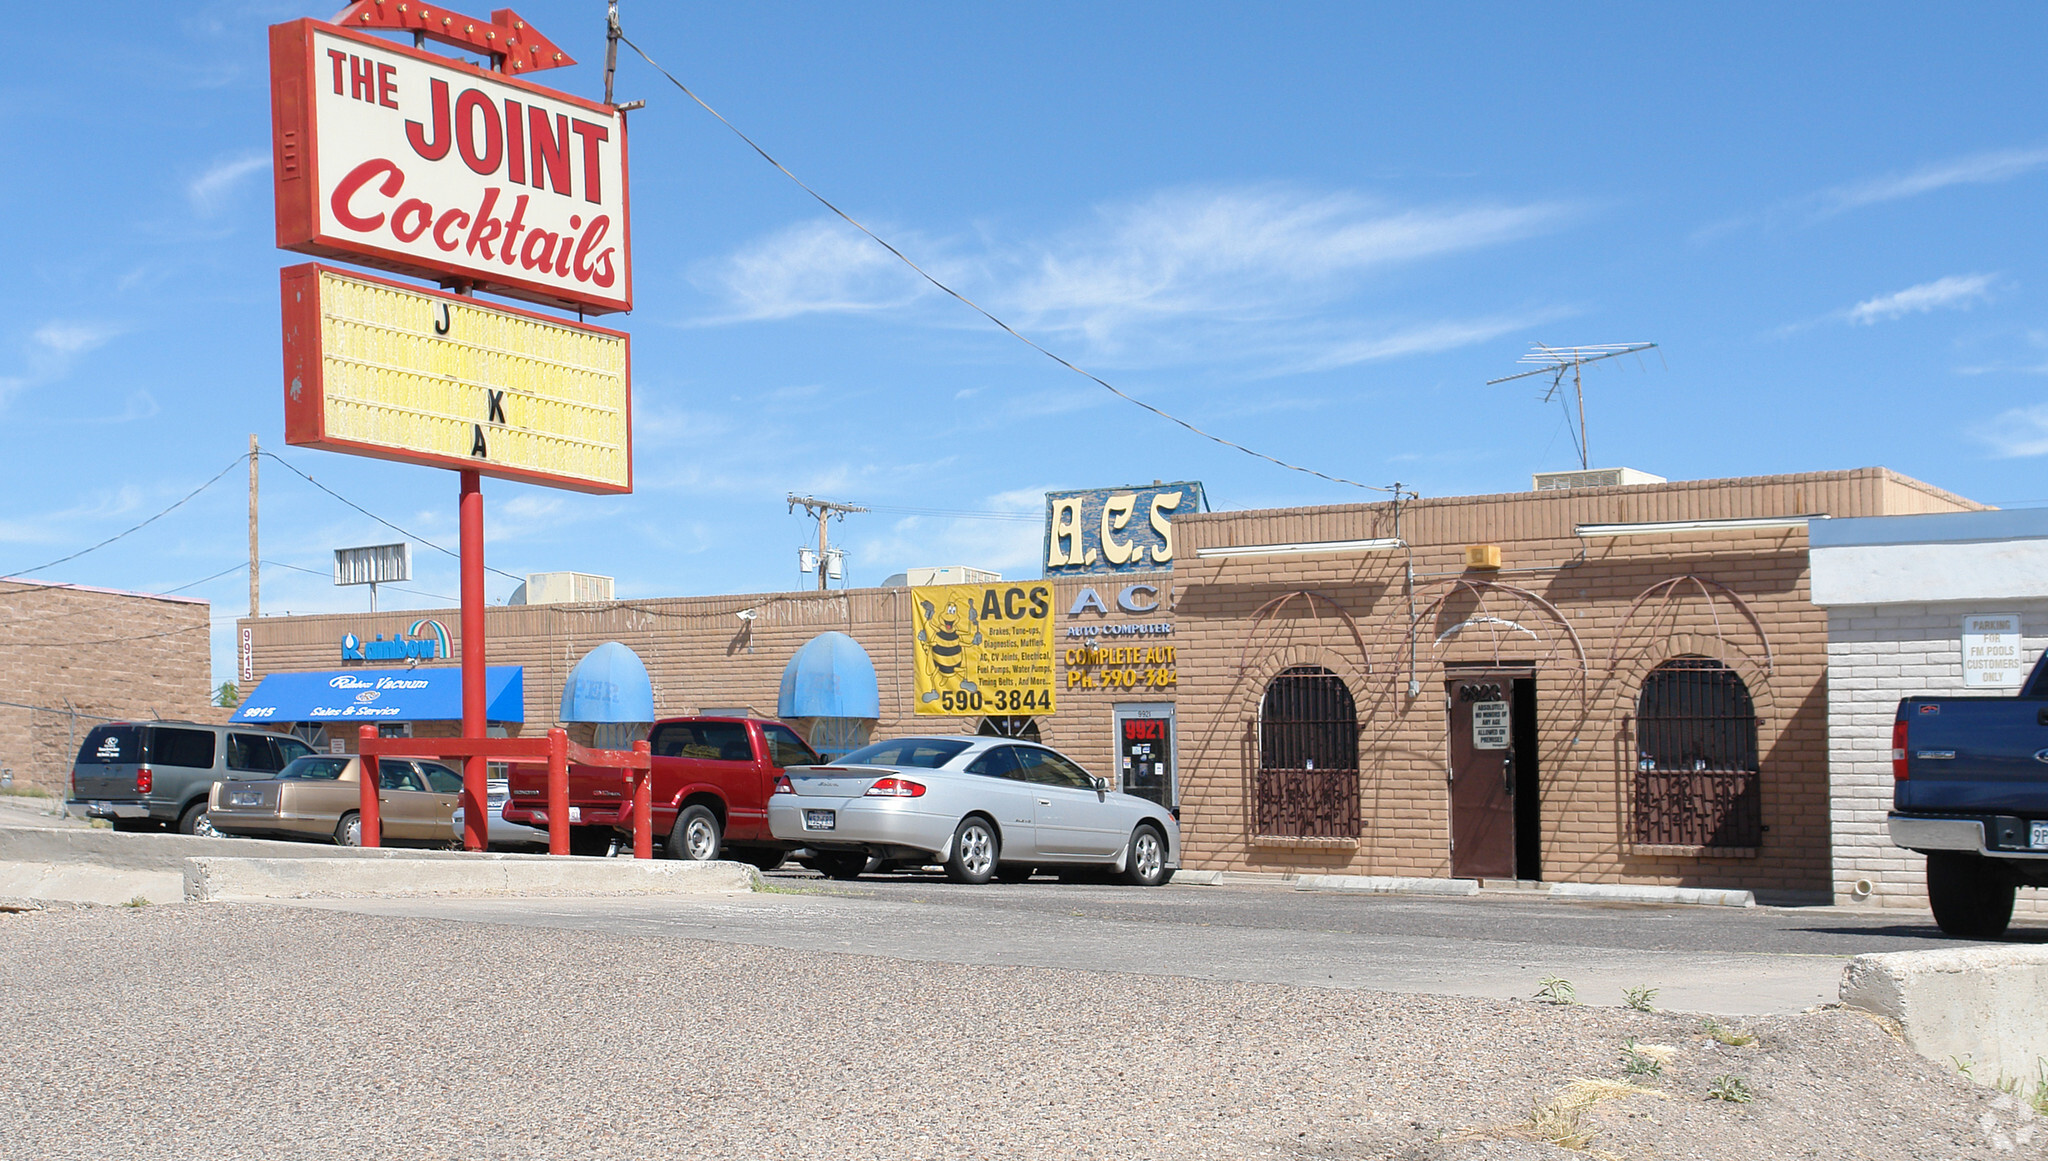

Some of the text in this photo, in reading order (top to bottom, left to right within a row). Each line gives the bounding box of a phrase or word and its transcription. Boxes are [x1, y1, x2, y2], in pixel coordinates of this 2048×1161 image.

[327, 48, 609, 205] THE JOINT
[330, 157, 616, 288] Cocktails
[435, 303, 450, 335] J
[488, 388, 506, 424] K
[470, 424, 488, 458] A
[980, 587, 1049, 620] ACS
[1068, 584, 1175, 614] AC
[989, 627, 1011, 636] Brakes,
[1067, 623, 1171, 637] AUTO COMPUTER
[1973, 620, 2011, 631] PARKING
[1984, 633, 2000, 643] FOR
[342, 632, 436, 660] Rainbow
[1971, 646, 2014, 656] FM POOLS
[243, 630, 252, 679] 9915
[991, 653, 999, 661] CV
[1065, 646, 1176, 666] COMPLETE AUT
[977, 665, 989, 674] Fuel
[1012, 664, 1030, 673] Water
[1966, 659, 2020, 669] CUSTOMERS
[376, 677, 429, 690] Vacuum
[978, 677, 997, 688] Timing
[1018, 677, 1029, 686] And
[1982, 672, 2004, 682] ONLY
[942, 690, 1051, 711] 590-3844
[243, 707, 276, 717] 9915
[310, 706, 400, 717] Sales & Service
[1125, 719, 1165, 739] 9921
